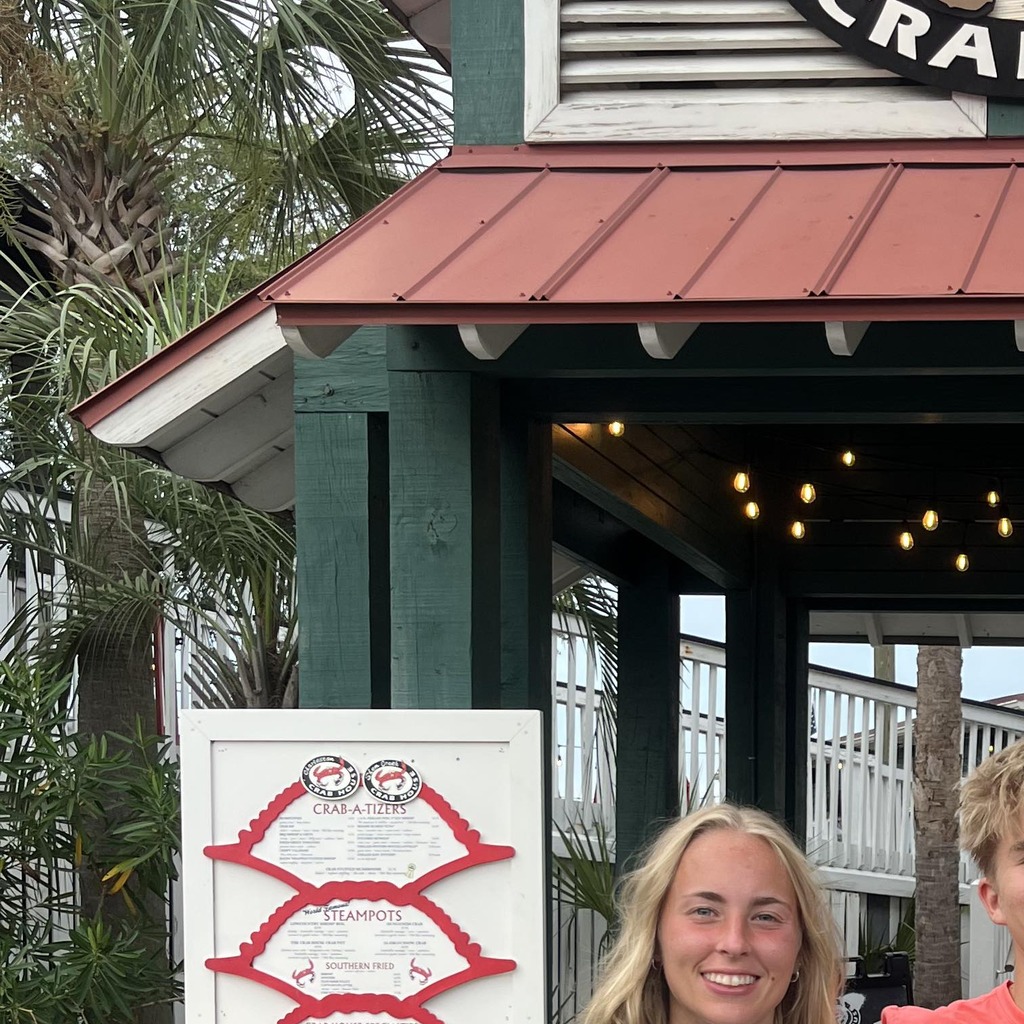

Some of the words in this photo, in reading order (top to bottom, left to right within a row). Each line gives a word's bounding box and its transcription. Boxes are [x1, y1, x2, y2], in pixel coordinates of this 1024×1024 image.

[308, 783, 334, 797] CRAB
[337, 766, 357, 796] HOUSE
[370, 787, 396, 801] CRAB
[399, 770, 418, 800] HOUSE
[313, 803, 407, 815] CRAB-A-TIZERS
[323, 909, 402, 922] STEAMPOTS
[326, 962, 370, 970] SOUTHERN
[372, 962, 395, 970] FRIED
